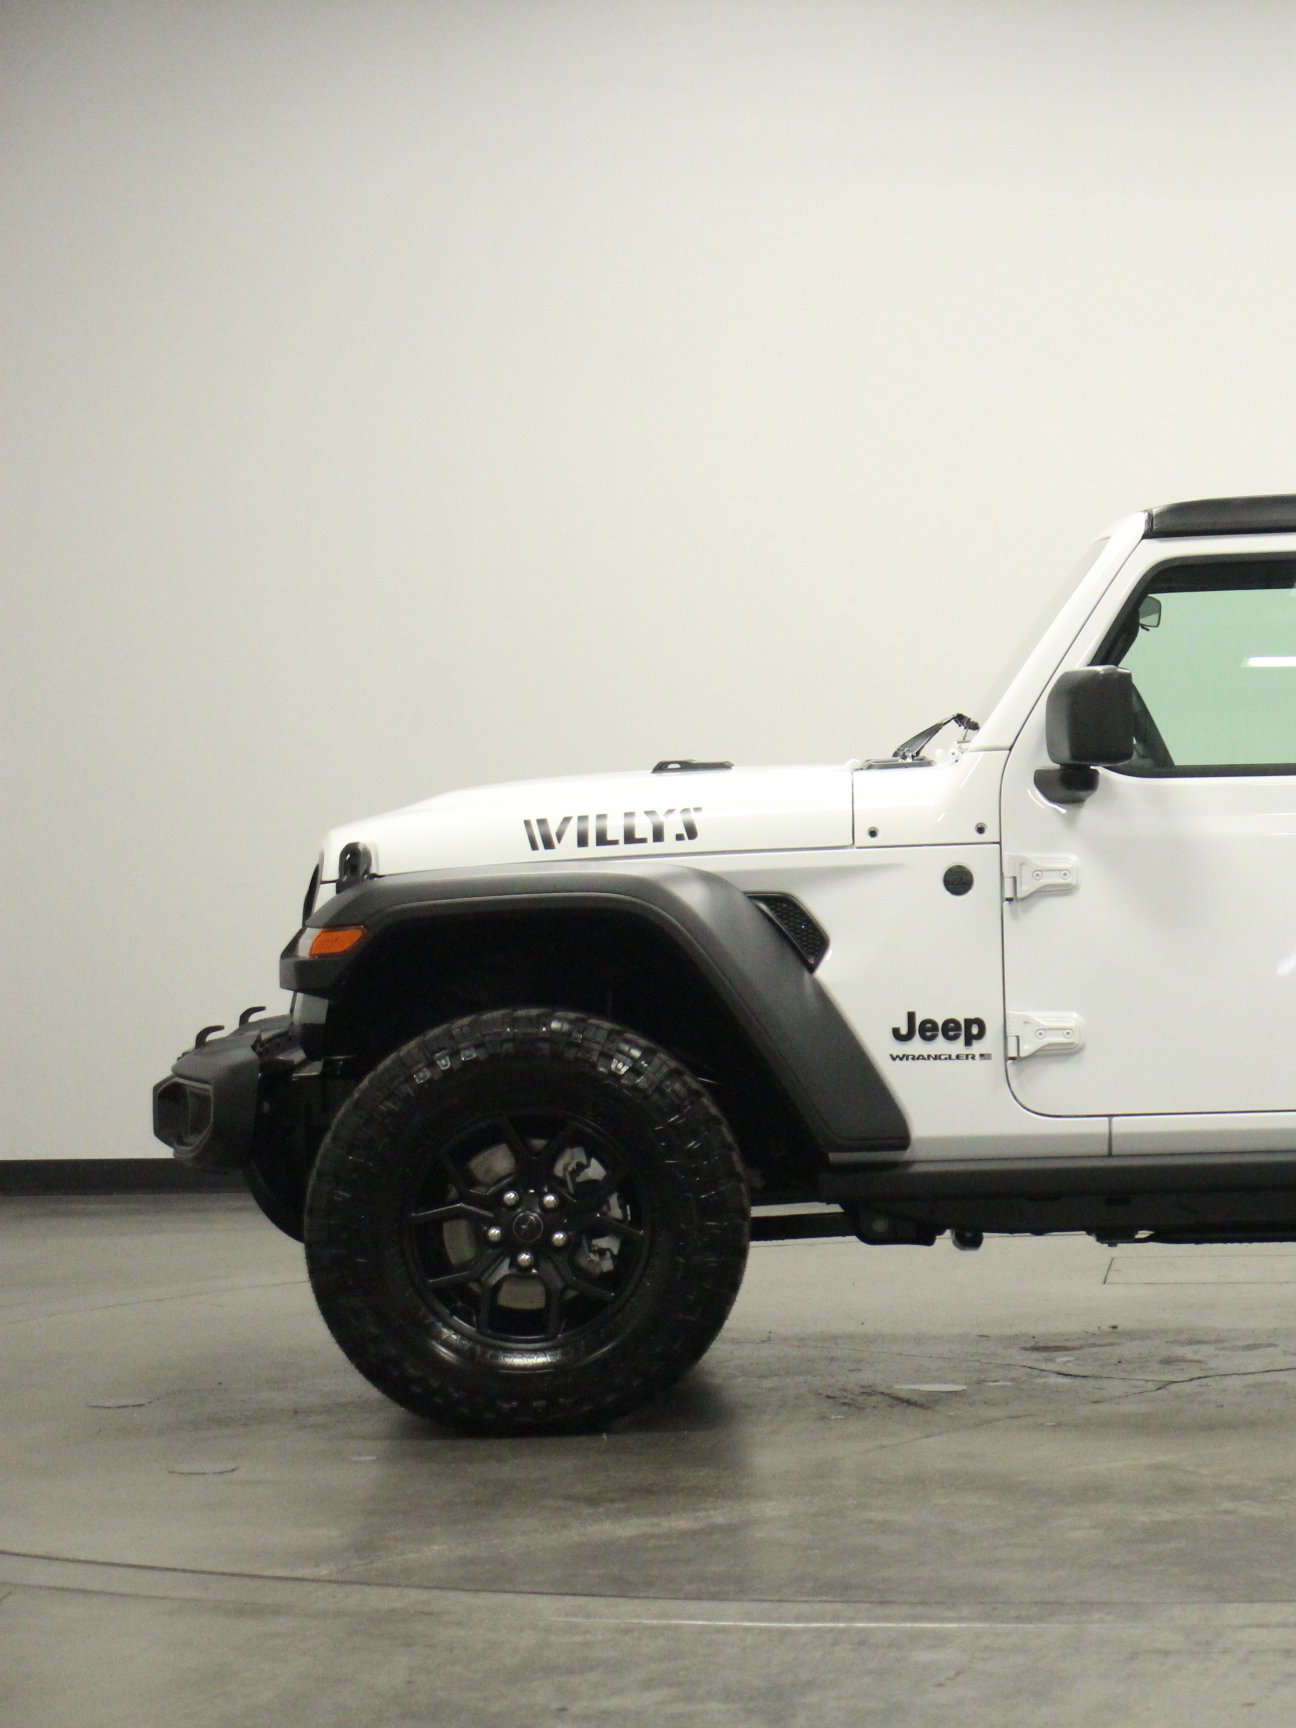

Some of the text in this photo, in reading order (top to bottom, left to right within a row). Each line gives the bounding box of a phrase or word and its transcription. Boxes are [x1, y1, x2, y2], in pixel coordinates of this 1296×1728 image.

[523, 807, 703, 851] WILLYS
[892, 1011, 986, 1047] Jeep
[889, 1053, 976, 1062] WRANGLER
